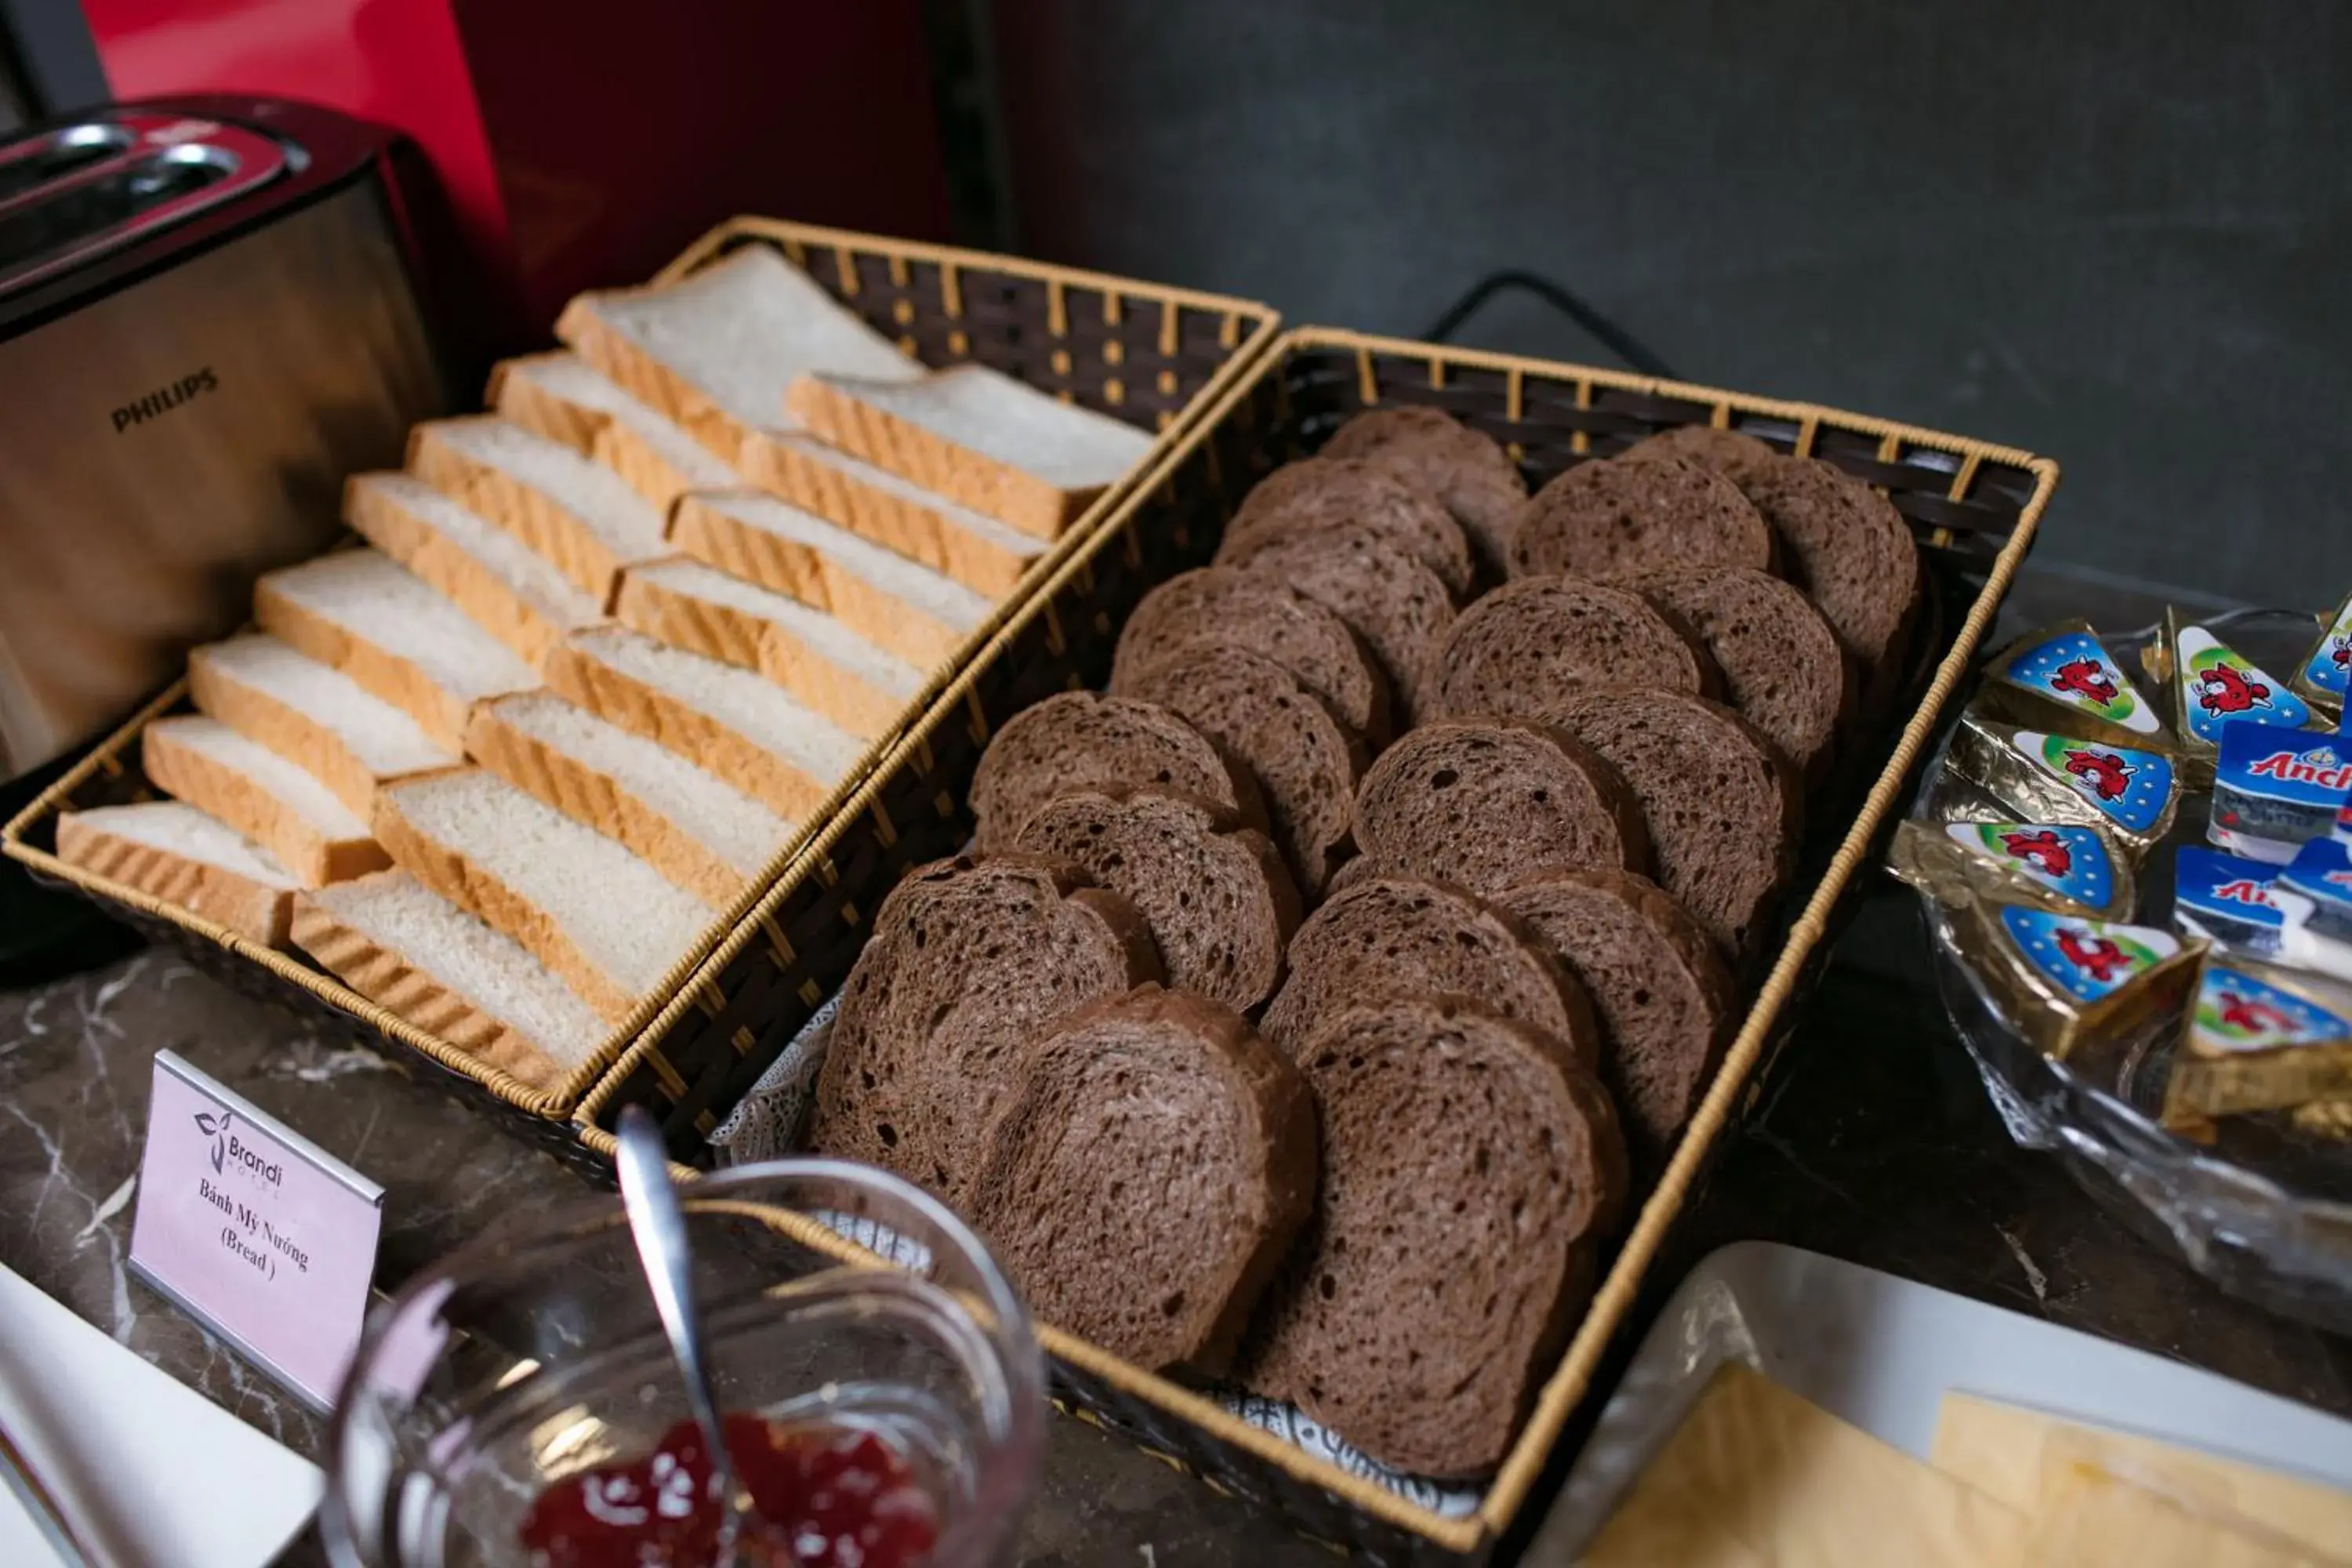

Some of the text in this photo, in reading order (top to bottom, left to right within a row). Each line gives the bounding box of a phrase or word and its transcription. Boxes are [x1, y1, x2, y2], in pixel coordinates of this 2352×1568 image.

[111, 365, 218, 433] PHILIPS
[229, 1135, 283, 1187] Brandi
[200, 1178, 233, 1216] Bánh
[262, 1221, 309, 1273] Nướng
